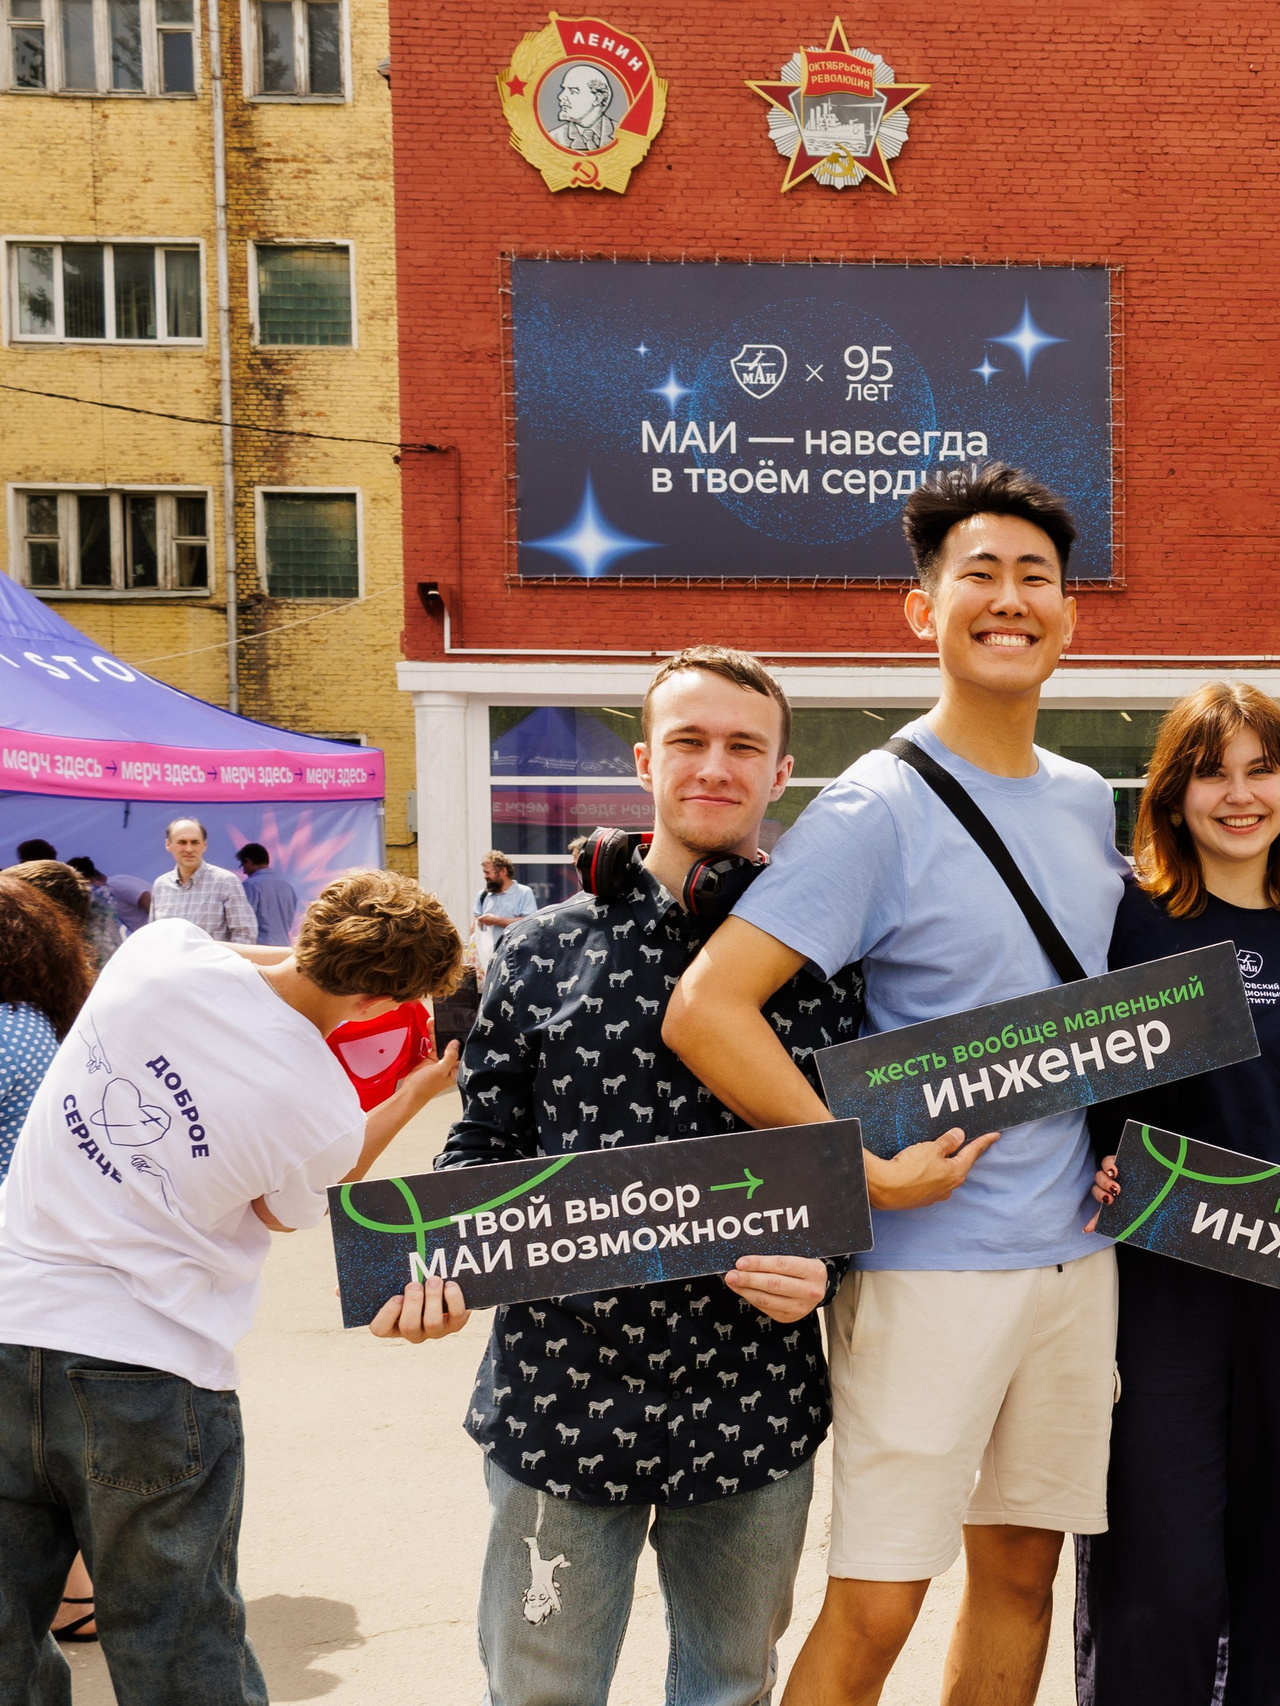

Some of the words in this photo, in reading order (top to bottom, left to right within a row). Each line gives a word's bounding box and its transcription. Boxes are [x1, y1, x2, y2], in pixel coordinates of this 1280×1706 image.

[572, 31, 644, 72] ЛЕНИН
[808, 61, 874, 78] ОКТЯБРЬСКАЯ
[811, 74, 871, 90] РЕВОЛЮЦИЯ
[843, 345, 894, 382] 95
[845, 383, 894, 401] лет
[641, 420, 737, 454] МАИ
[805, 429, 989, 461] навсегда
[651, 468, 673, 493] в
[684, 460, 809, 494] твоём
[3, 748, 52, 779] мерч
[54, 754, 103, 780] здесь
[121, 761, 162, 787] мерч
[164, 763, 206, 786] здесь
[220, 766, 256, 790] мерч
[258, 767, 294, 787] здесь
[306, 767, 336, 790] мерч
[337, 768, 368, 787] здесь
[1243, 982, 1280, 990] ОВСКИЙ
[865, 1050, 947, 1087] жесть
[952, 1020, 1058, 1064] вообще
[1065, 975, 1205, 1033] маленький
[922, 1018, 1171, 1119] инженер
[145, 1055, 210, 1159] ДОБРОЕ
[450, 1194, 553, 1240] твой
[566, 1180, 700, 1226] выбор
[408, 1237, 524, 1283] МАИ
[527, 1205, 811, 1268] возможности
